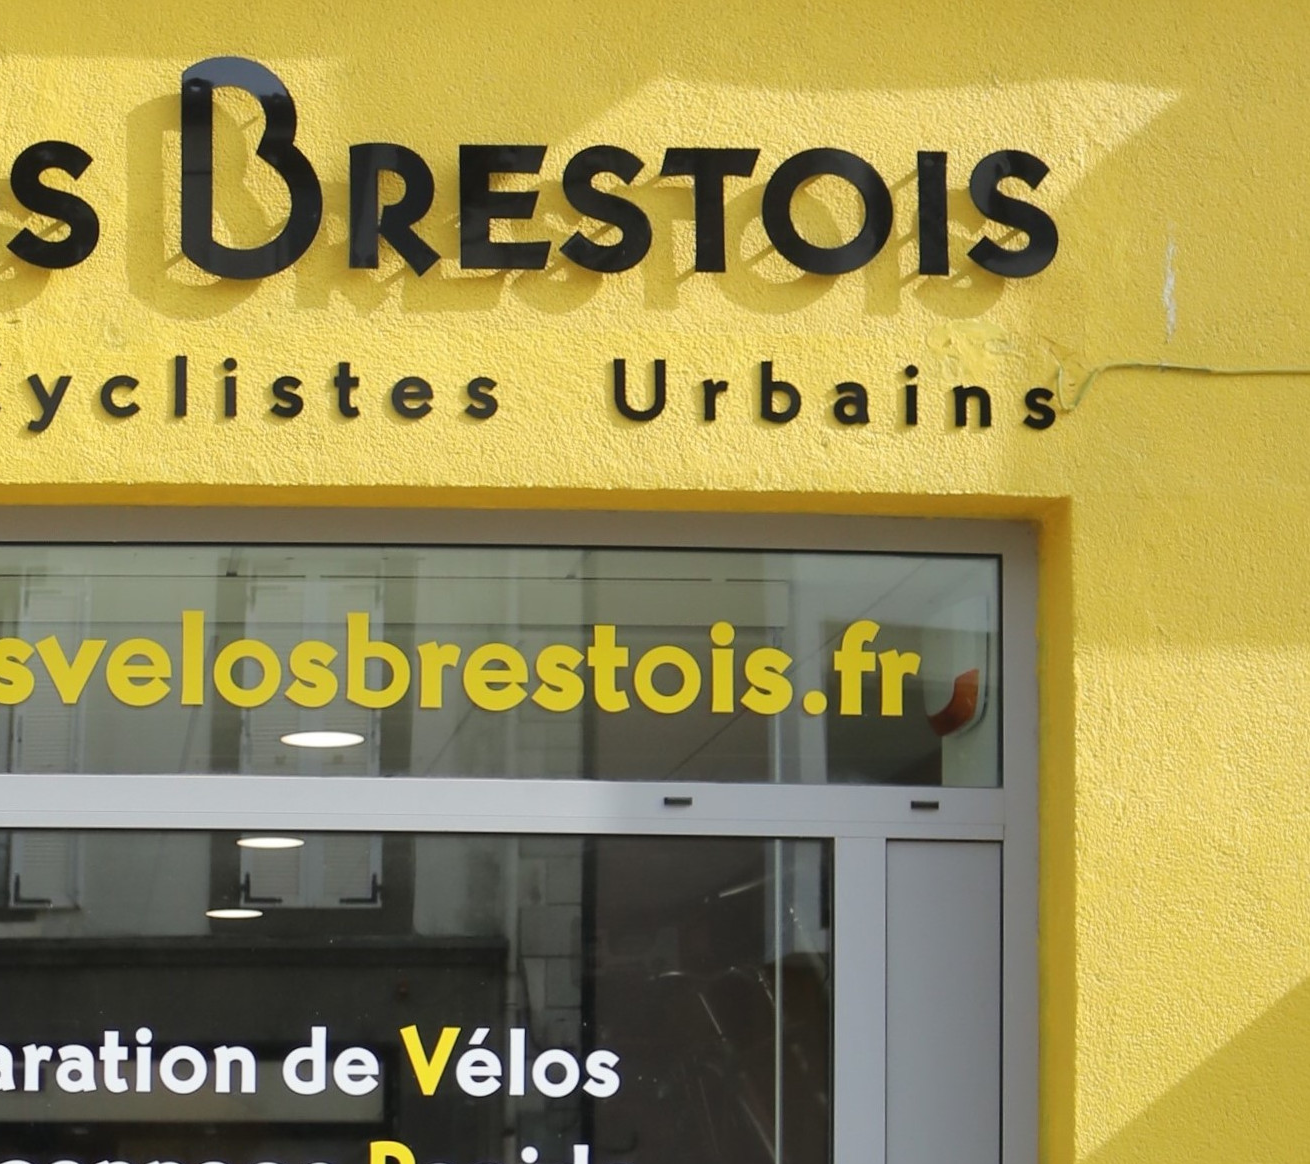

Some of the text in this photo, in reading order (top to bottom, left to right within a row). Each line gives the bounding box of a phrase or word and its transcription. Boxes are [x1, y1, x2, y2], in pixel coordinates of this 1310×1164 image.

[181, 57, 1059, 280] BRESTOIS
[614, 359, 1055, 430] Urbains
[283, 1027, 378, 1095] de
[400, 1025, 619, 1097] Vélos
